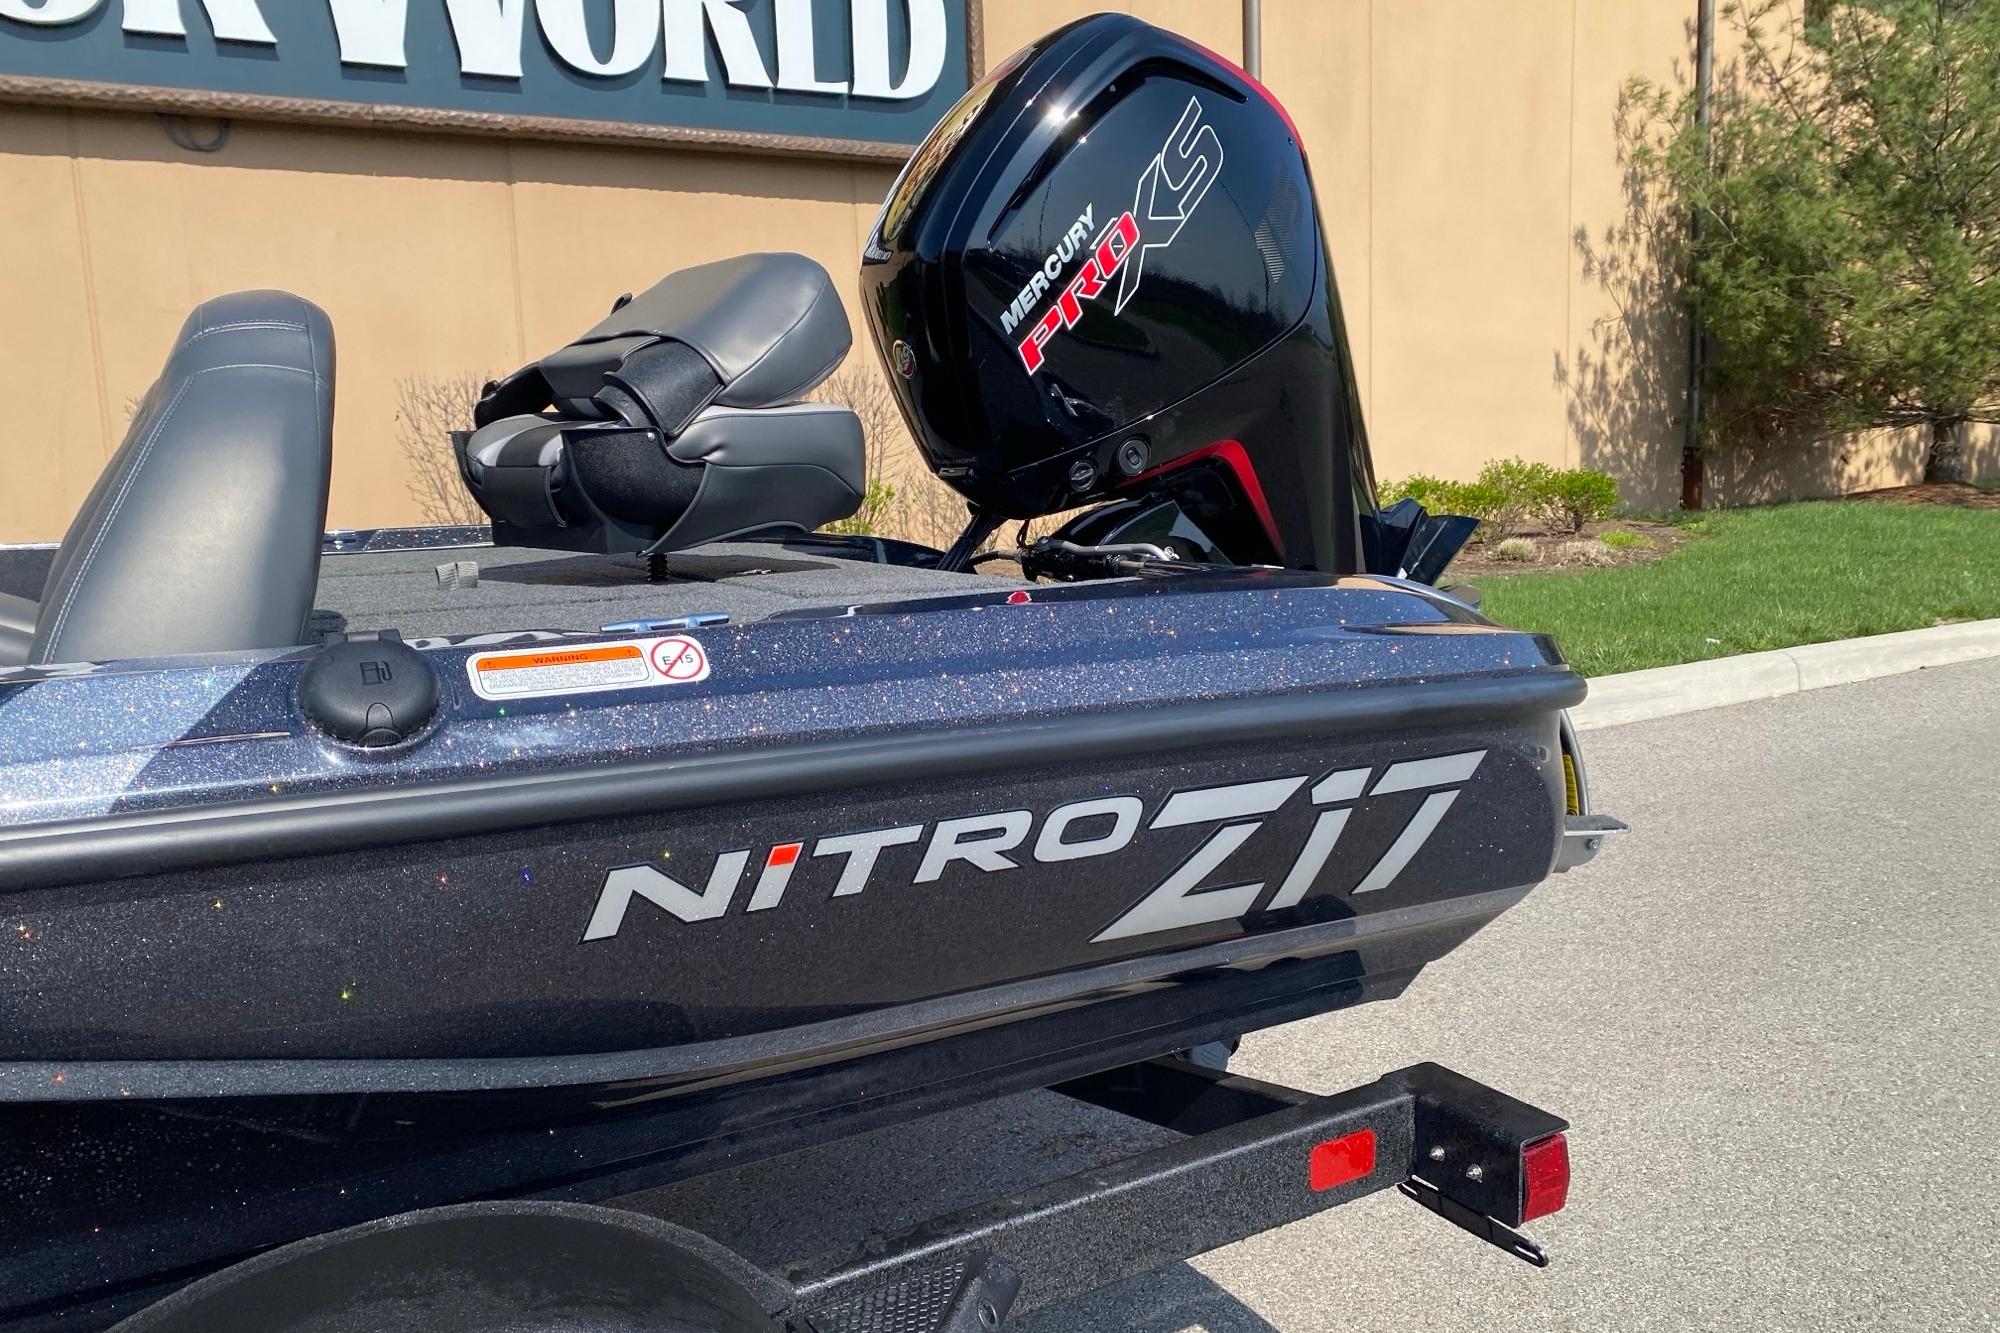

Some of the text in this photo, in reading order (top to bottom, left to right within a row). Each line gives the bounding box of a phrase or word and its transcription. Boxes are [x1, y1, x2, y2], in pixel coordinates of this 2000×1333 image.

[1000, 203, 1094, 335] MERCURY
[1018, 97, 1223, 376] PRO XS
[533, 653, 588, 664] WARNING
[1089, 749, 1488, 943] Z17
